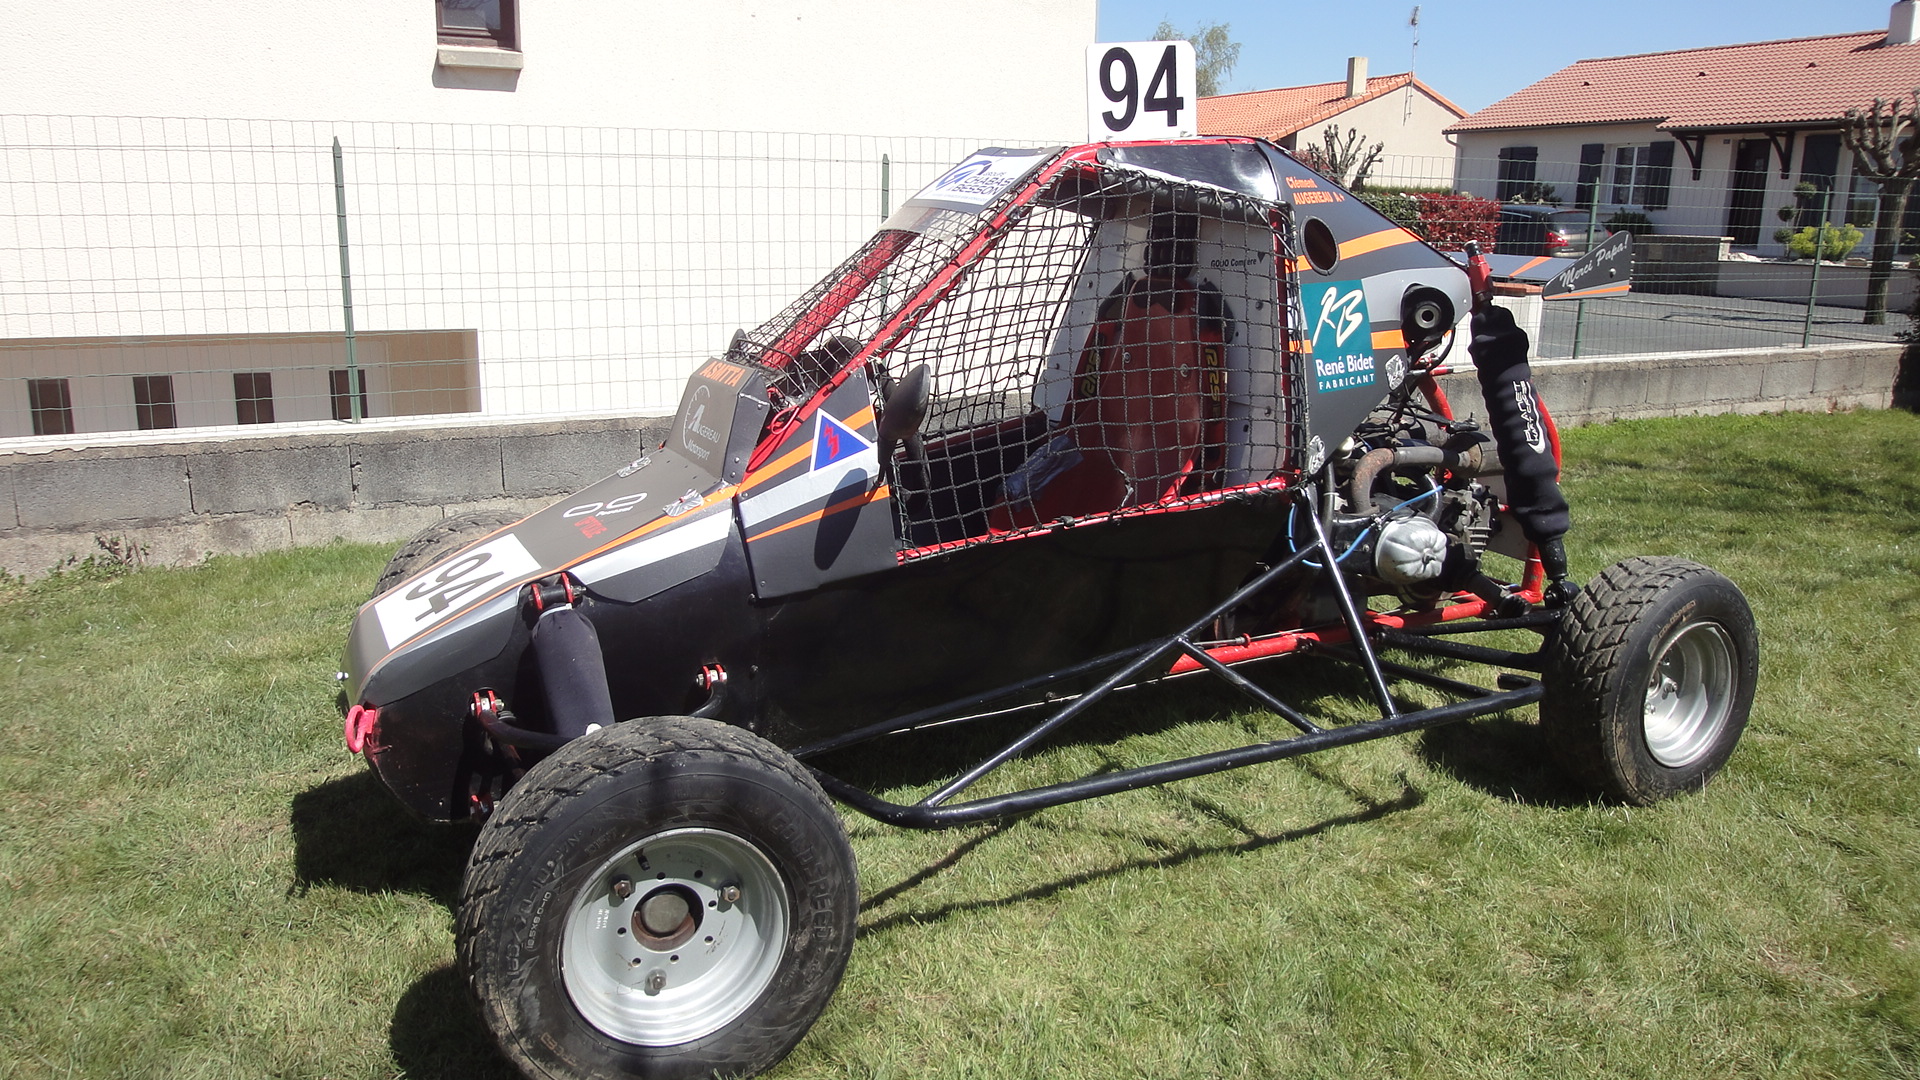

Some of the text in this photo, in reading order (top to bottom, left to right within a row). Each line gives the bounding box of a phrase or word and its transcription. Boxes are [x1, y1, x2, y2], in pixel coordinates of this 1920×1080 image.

[1099, 45, 1184, 132] 94
[964, 176, 1015, 186] CHABAS
[1293, 191, 1334, 205] AUGEREAU
[1560, 234, 1629, 287] Merci Papa!
[1315, 353, 1374, 378] René Bidet
[1319, 373, 1375, 391] FABRICANT
[688, 404, 721, 444] AUGEREAU
[1513, 381, 1533, 442] PLANET
[688, 439, 711, 460] Motorsport
[405, 552, 504, 622] 94
